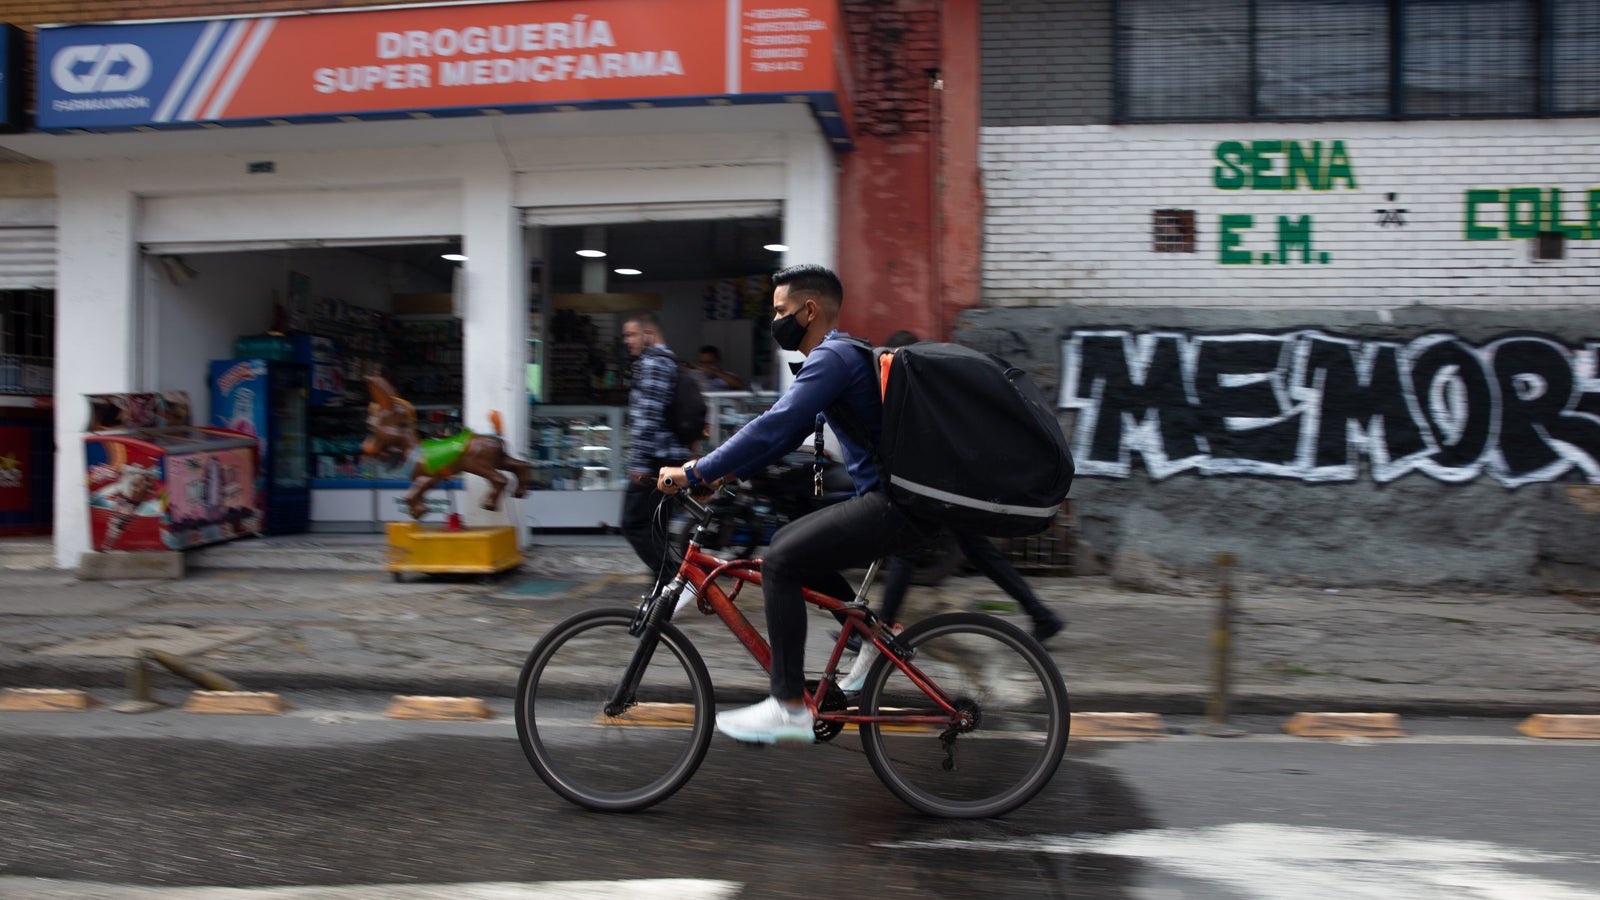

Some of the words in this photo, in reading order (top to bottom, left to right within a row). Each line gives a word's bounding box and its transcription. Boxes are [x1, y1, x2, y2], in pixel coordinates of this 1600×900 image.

[376, 14, 615, 59] DROGUERÍA
[313, 63, 431, 93] SUPER
[438, 50, 685, 86] MEDICFARMA
[1213, 140, 1358, 190] SENA
[1218, 213, 1332, 264] E.M.
[1058, 328, 1600, 488] MEMOR
